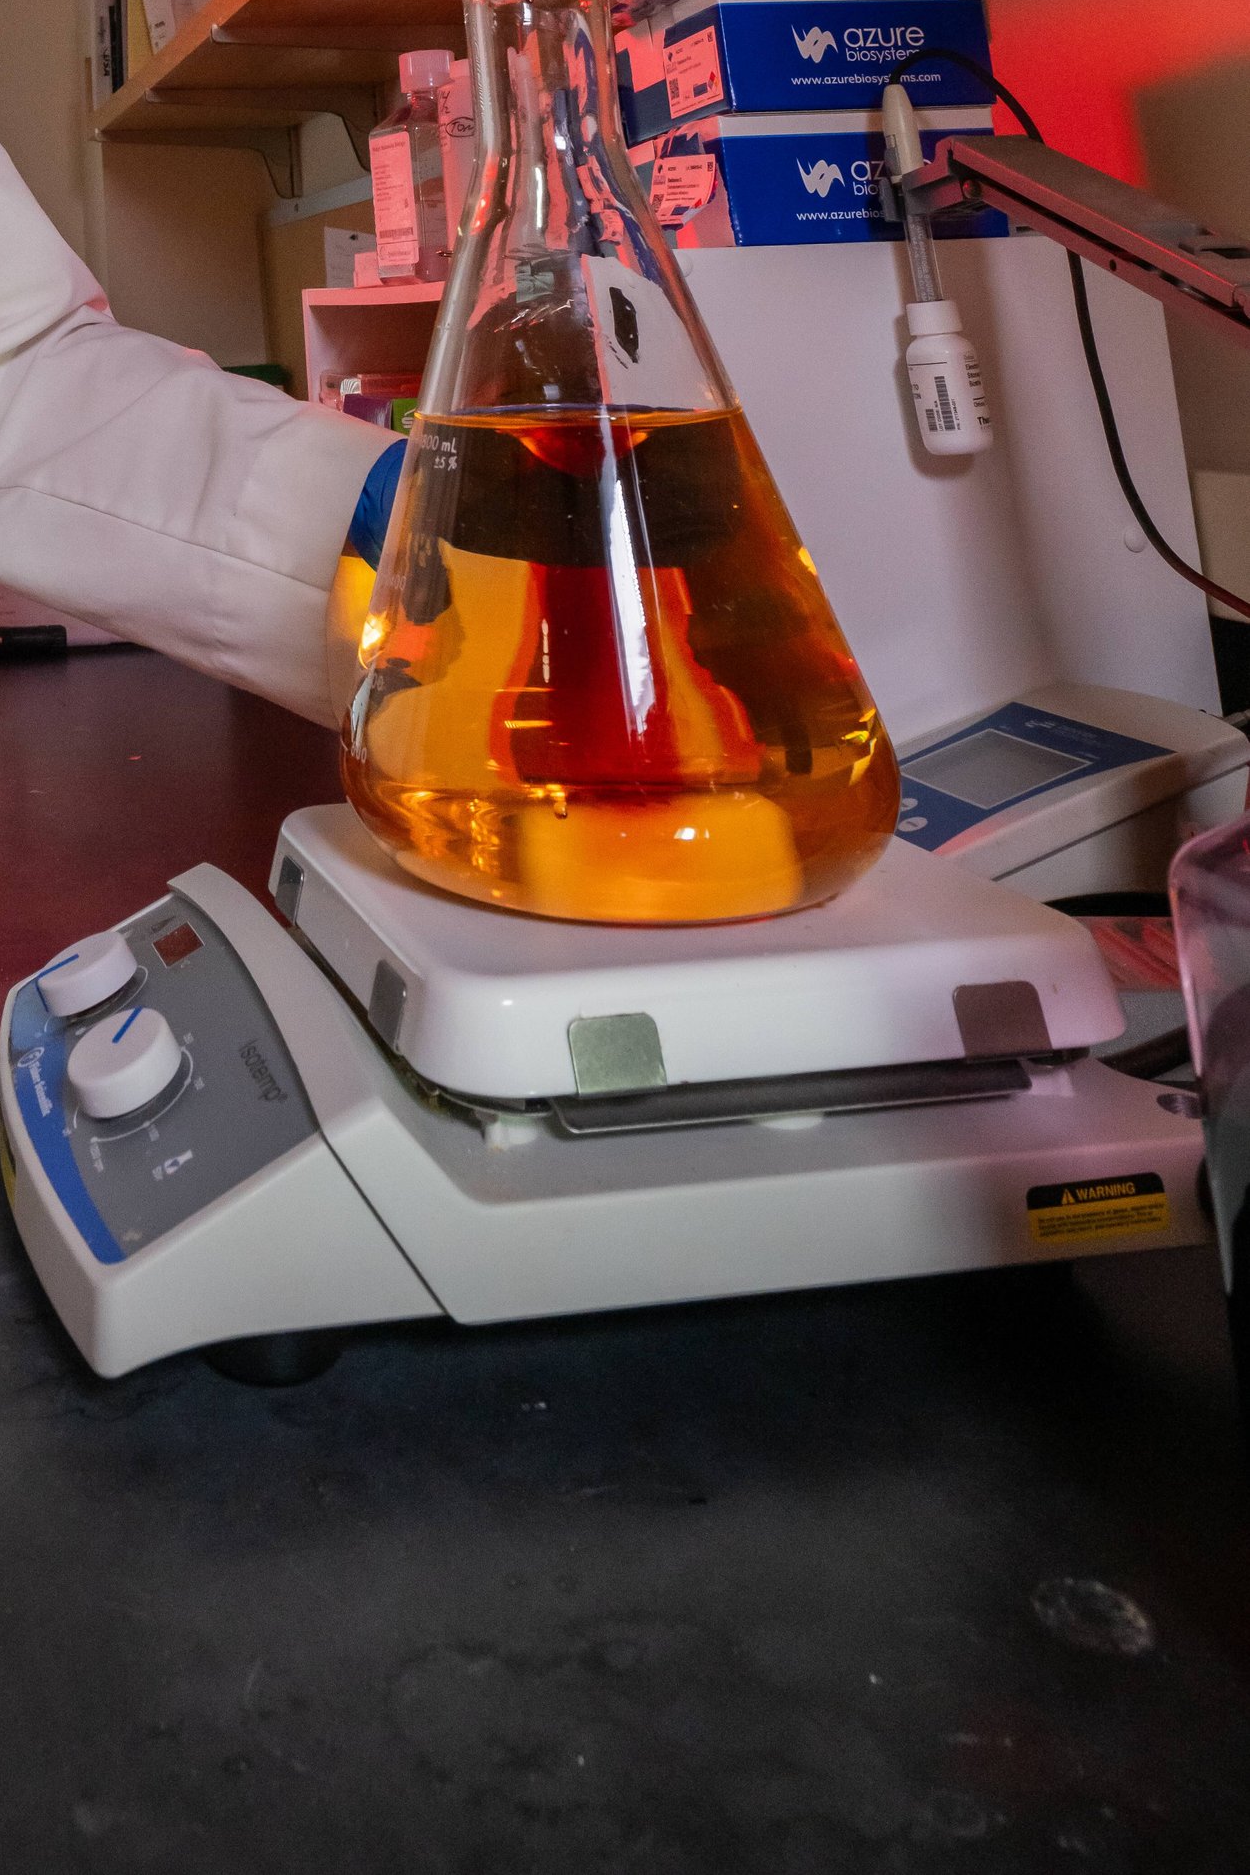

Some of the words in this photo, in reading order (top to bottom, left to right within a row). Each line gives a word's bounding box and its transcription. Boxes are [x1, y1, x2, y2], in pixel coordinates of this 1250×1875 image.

[843, 26, 925, 48] azure
[791, 73, 942, 87] www.azurebiosysms.com
[1075, 1181, 1136, 1202] WARNING
